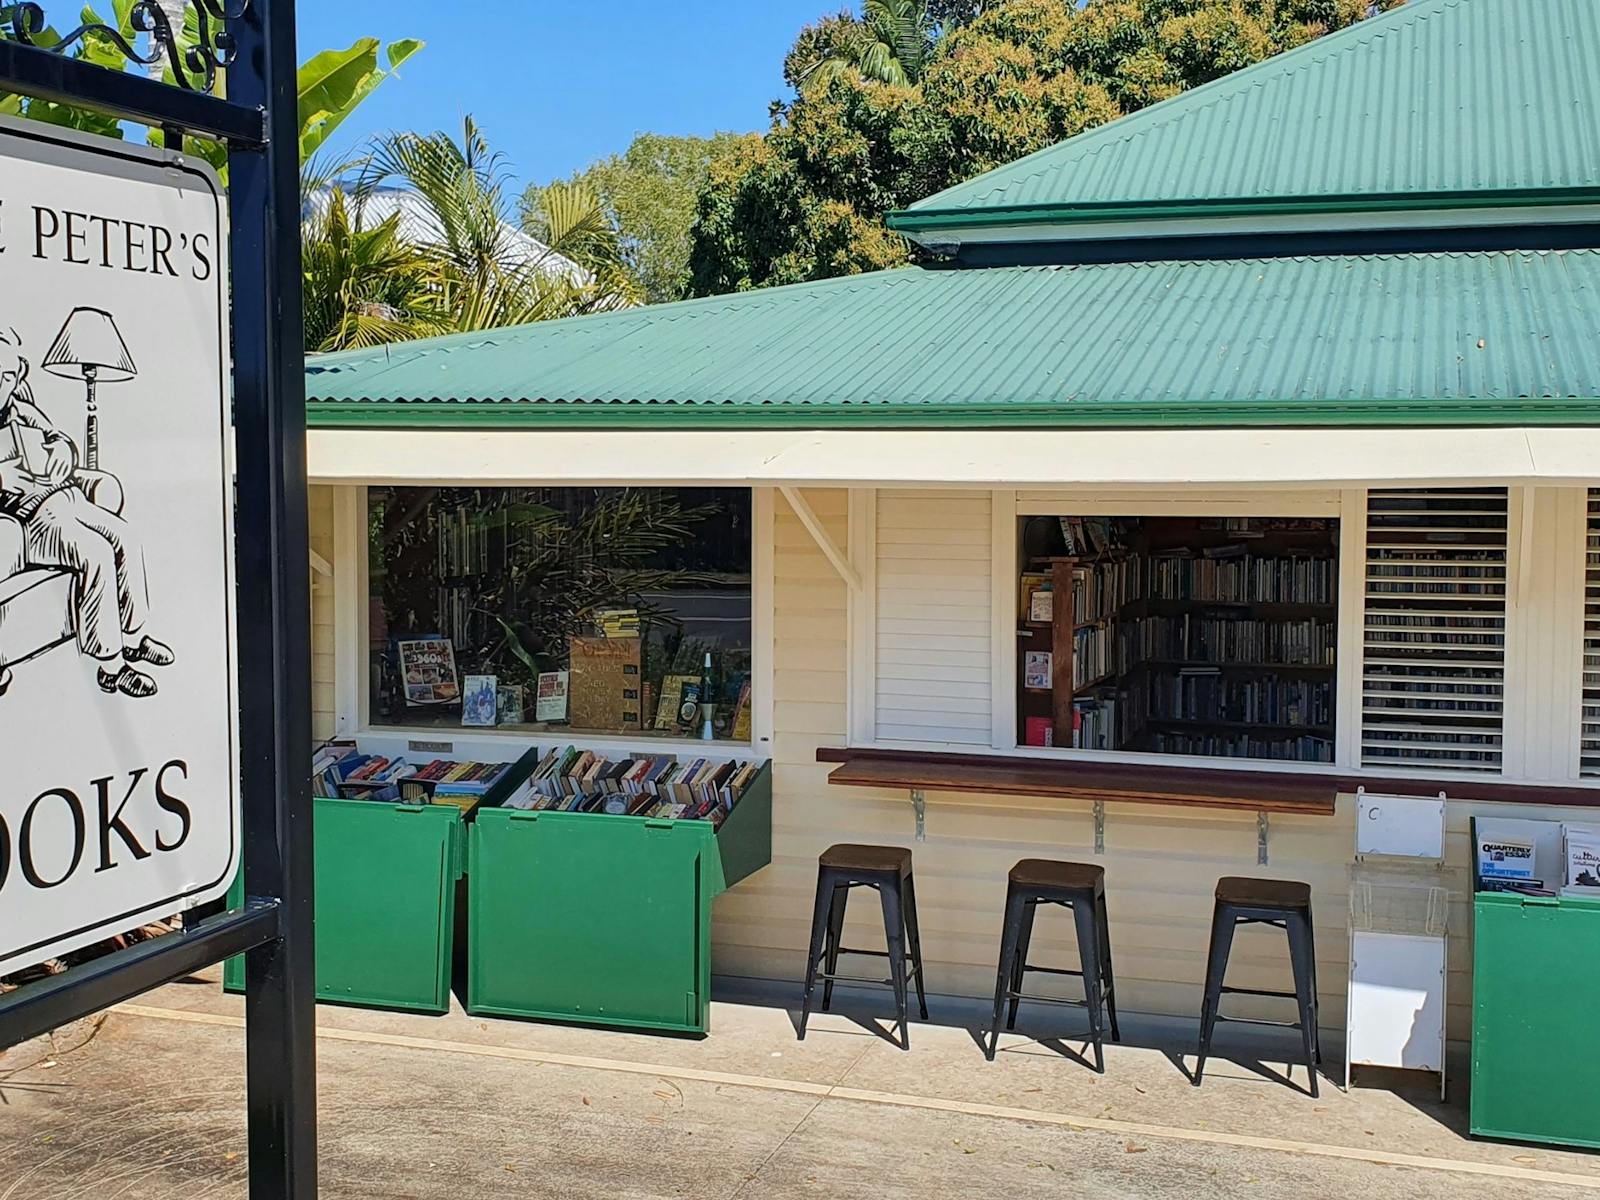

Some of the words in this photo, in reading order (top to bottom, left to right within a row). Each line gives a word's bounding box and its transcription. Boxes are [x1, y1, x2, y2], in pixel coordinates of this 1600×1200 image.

[31, 205, 211, 281] PETER'S
[0, 759, 191, 893] OKS
[1482, 844, 1531, 853] QUARTERLY
